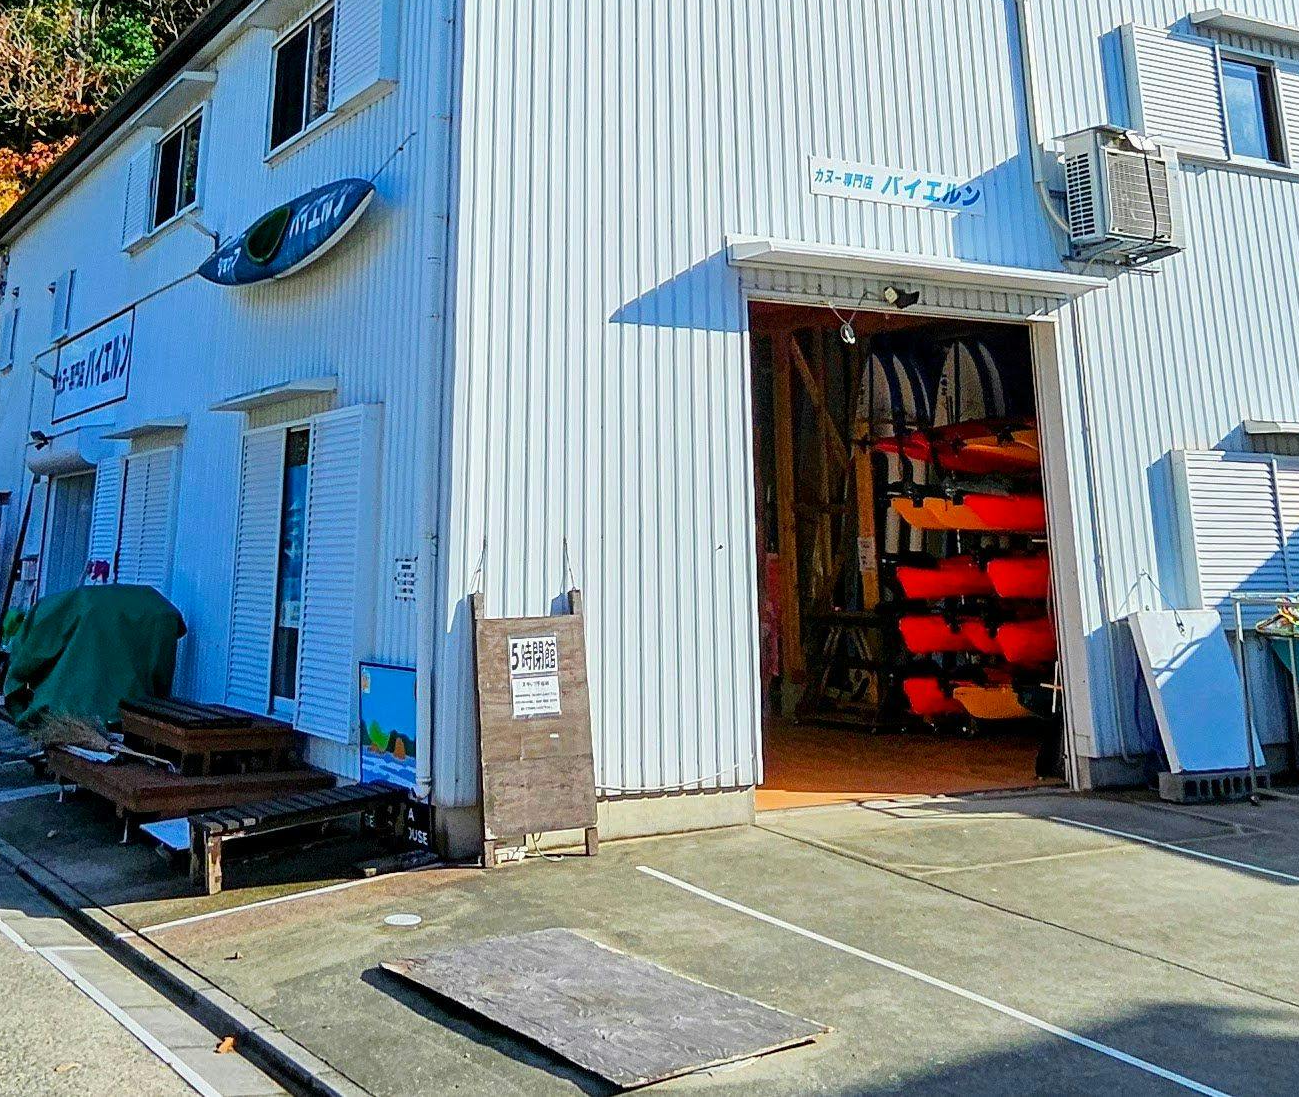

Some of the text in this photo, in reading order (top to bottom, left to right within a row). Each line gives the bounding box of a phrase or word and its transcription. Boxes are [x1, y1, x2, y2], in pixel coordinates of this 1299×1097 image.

[814, 167, 981, 206] カヌー専門店 バイエルン
